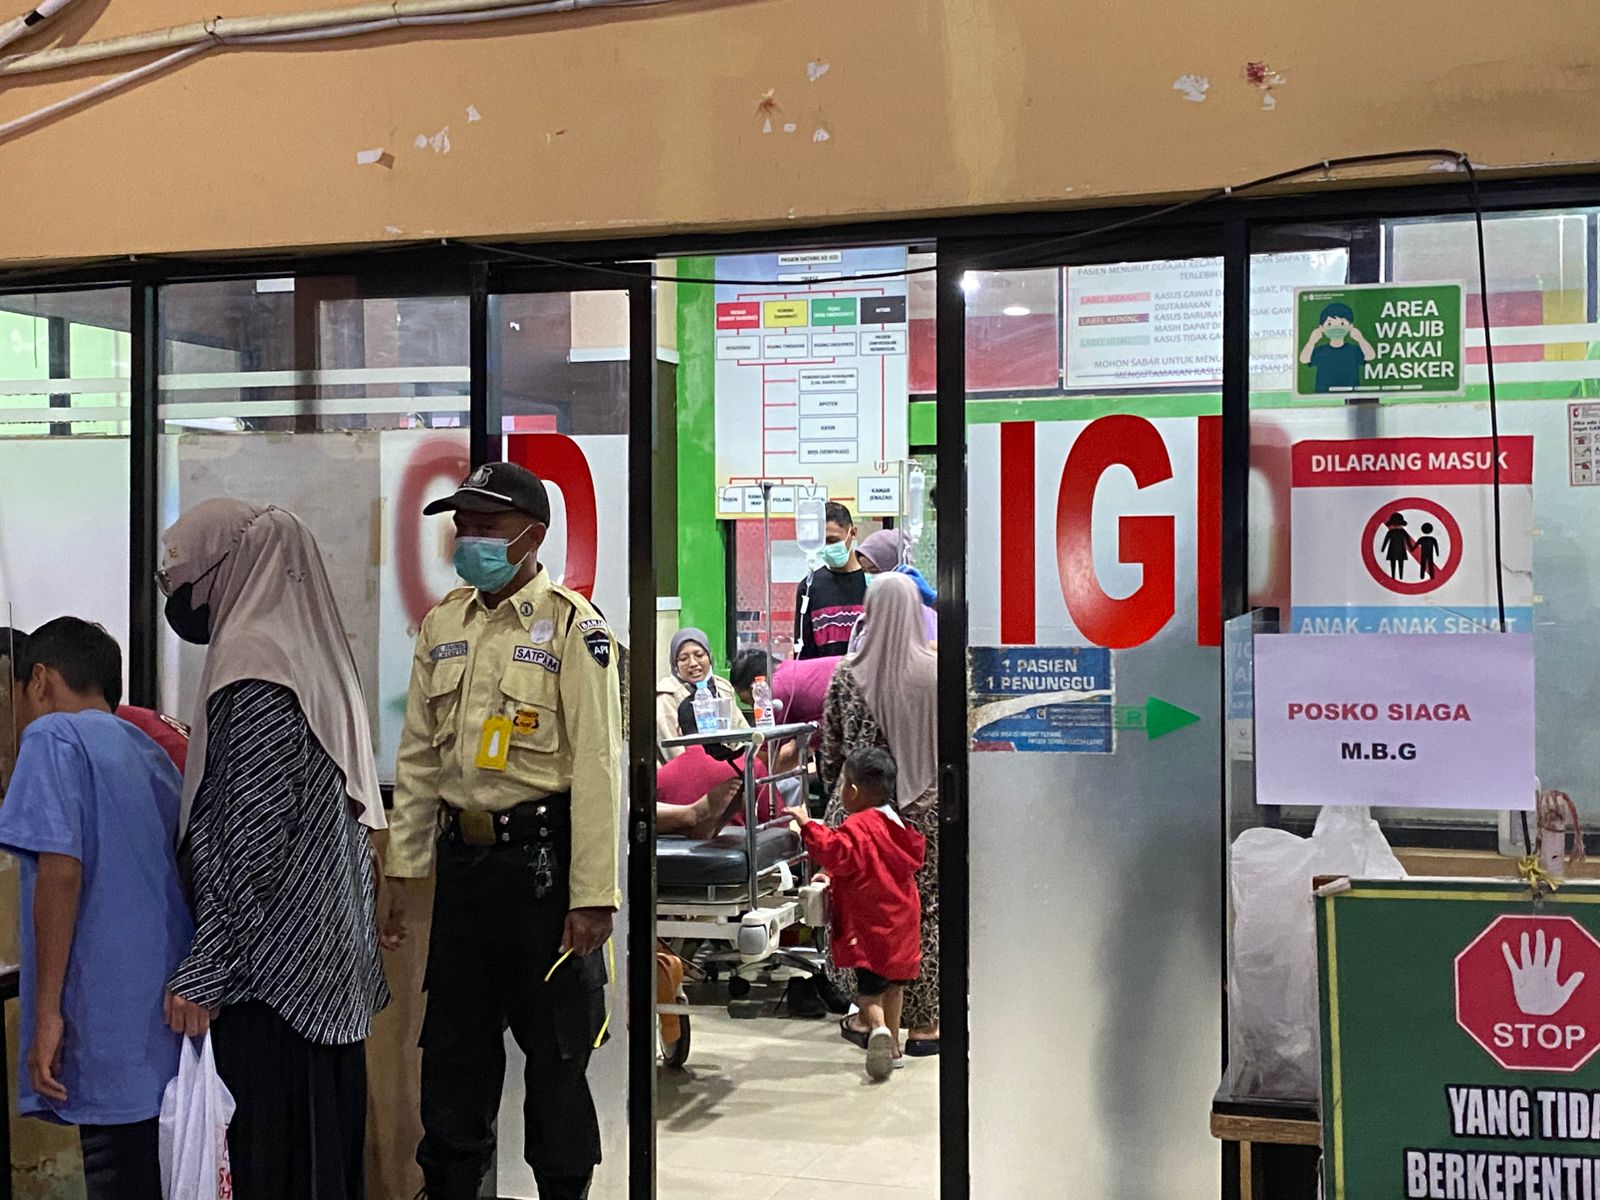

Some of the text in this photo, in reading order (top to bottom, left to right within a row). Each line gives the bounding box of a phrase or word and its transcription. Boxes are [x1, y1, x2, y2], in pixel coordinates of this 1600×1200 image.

[1078, 267, 1106, 275] PASIEN
[1108, 264, 1150, 273] MENURUT
[1180, 271, 1218, 280] TERLEBIH
[1155, 291, 1181, 300] KASUS
[1155, 301, 1211, 311] DIUTAMAKAN
[1381, 300, 1439, 318] AREA
[1155, 312, 1181, 321] KASUS
[1375, 320, 1444, 338] WAJIB
[1377, 341, 1442, 359] PAKAI
[1095, 360, 1128, 369] MOHON
[1130, 358, 1160, 367] SABAR
[1161, 356, 1194, 365] UNTUK
[1364, 361, 1454, 380] MASKER
[1311, 451, 1509, 473] DILARANG MASUK
[1301, 617, 1360, 634] ANAK
[1378, 617, 1437, 634] ANAK
[516, 648, 559, 672] SATPAM
[1002, 659, 1077, 673] 1 PASIEN
[986, 676, 1095, 690] 1 PENUNGGU
[1287, 703, 1471, 721] POSKO SIAGA
[1341, 743, 1417, 760] M.B.G
[1493, 1022, 1586, 1050] STOP
[1448, 1087, 1530, 1137] YANG
[1406, 1151, 1600, 1200] BERKEPENTI
